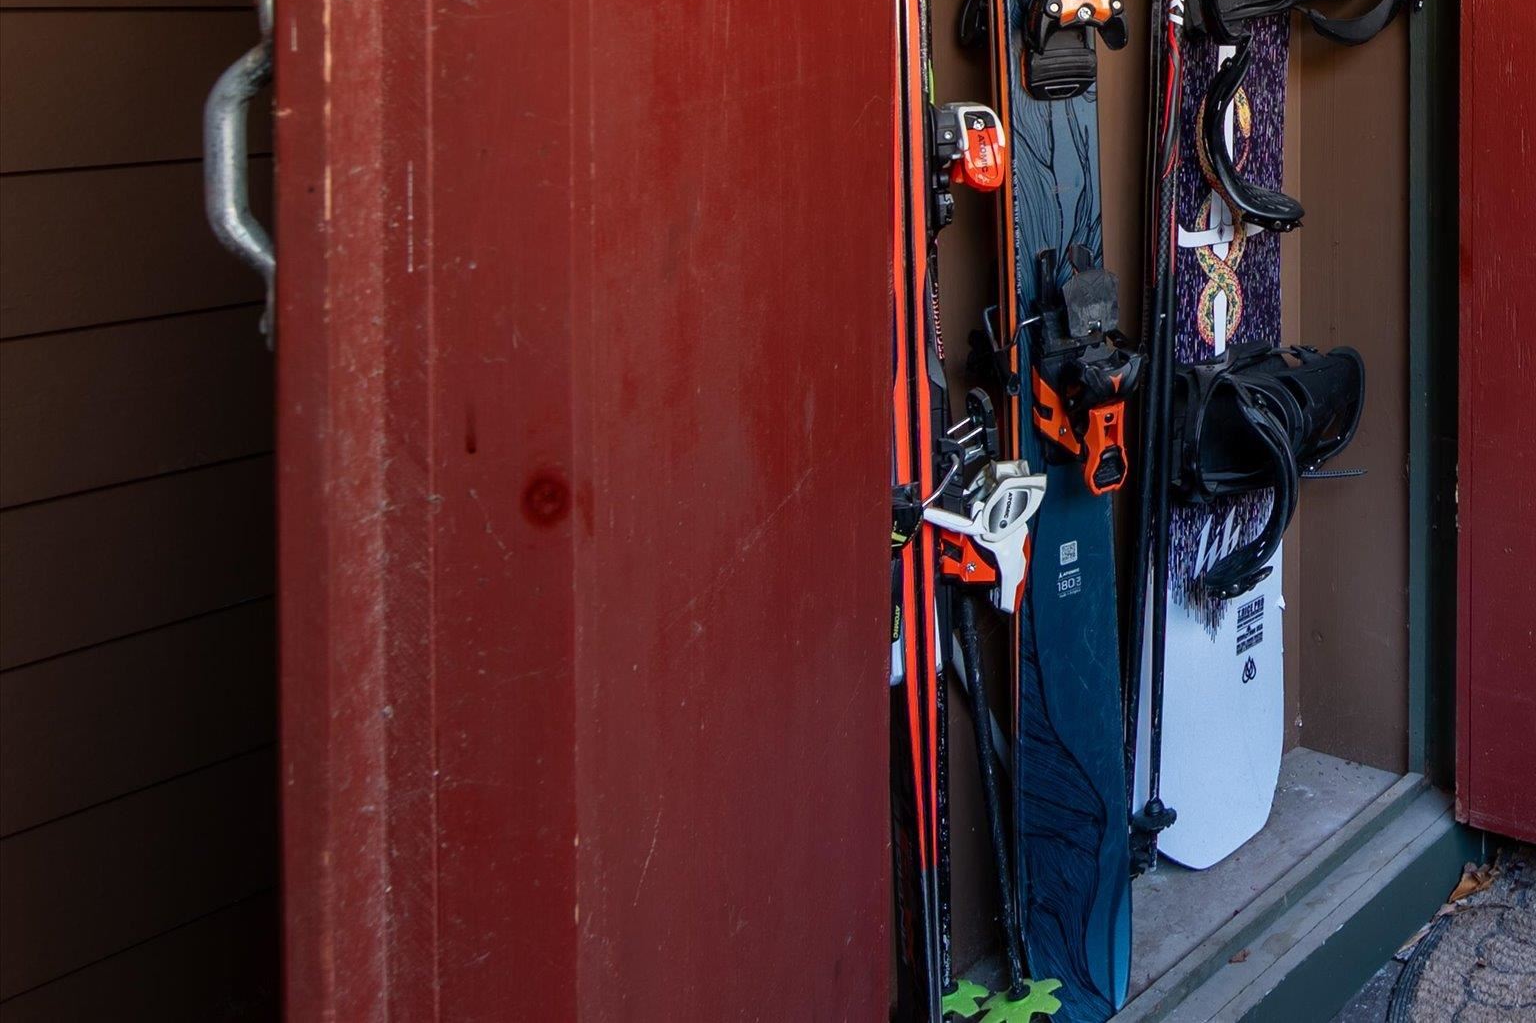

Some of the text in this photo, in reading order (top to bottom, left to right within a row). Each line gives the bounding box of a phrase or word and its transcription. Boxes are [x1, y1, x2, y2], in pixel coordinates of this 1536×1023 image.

[976, 134, 989, 173] ATOMIC
[1003, 492, 1013, 518] ATOMIC
[892, 604, 901, 639] ATOMIC
